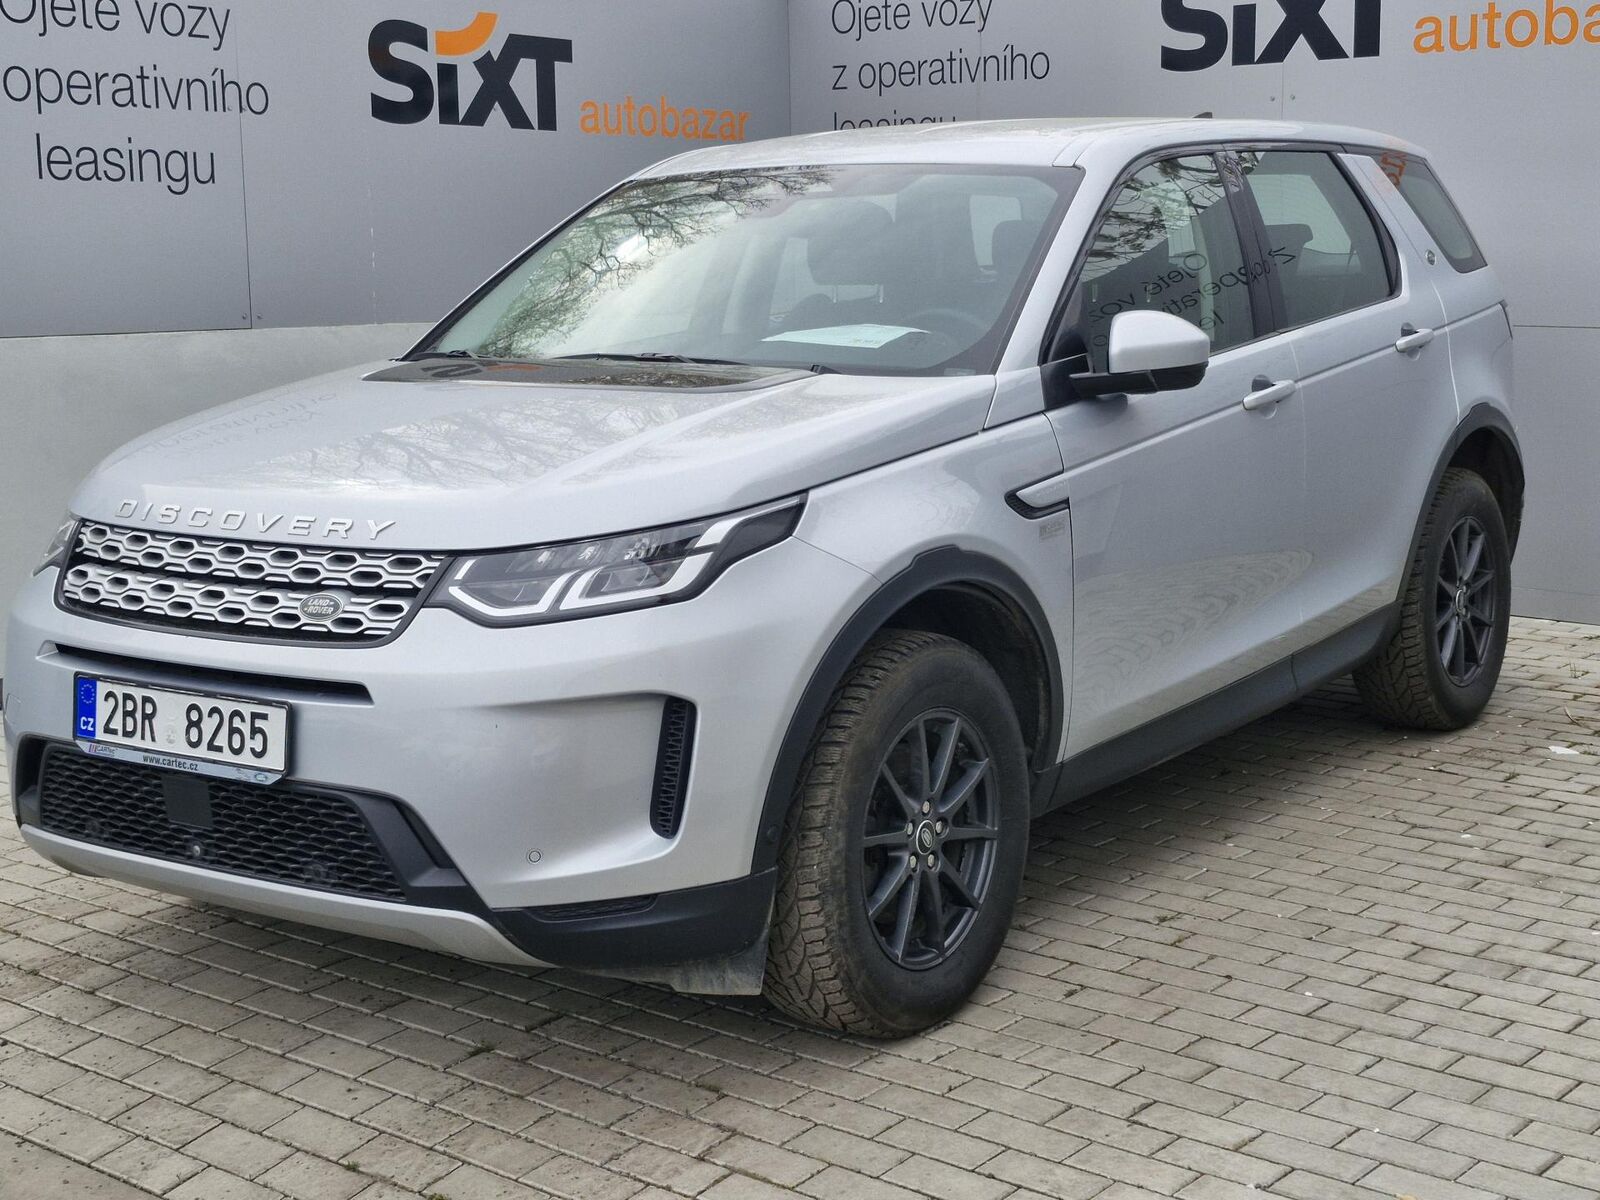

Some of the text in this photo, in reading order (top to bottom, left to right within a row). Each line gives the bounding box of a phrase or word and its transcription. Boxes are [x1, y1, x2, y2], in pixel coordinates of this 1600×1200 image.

[134, 0, 231, 51] vozy
[921, 0, 993, 33] vozy
[2, 63, 269, 116] operativního
[831, 43, 1050, 97] z operativního
[578, 95, 751, 142] autobazar
[35, 132, 216, 196] leasingu
[114, 498, 397, 541] DISCOVERY
[306, 605, 334, 615] ROVER
[307, 598, 331, 606] LAND
[79, 715, 95, 732] CZ
[102, 690, 269, 759] 2BR 8265
[142, 753, 199, 772] www.cartec.cz
